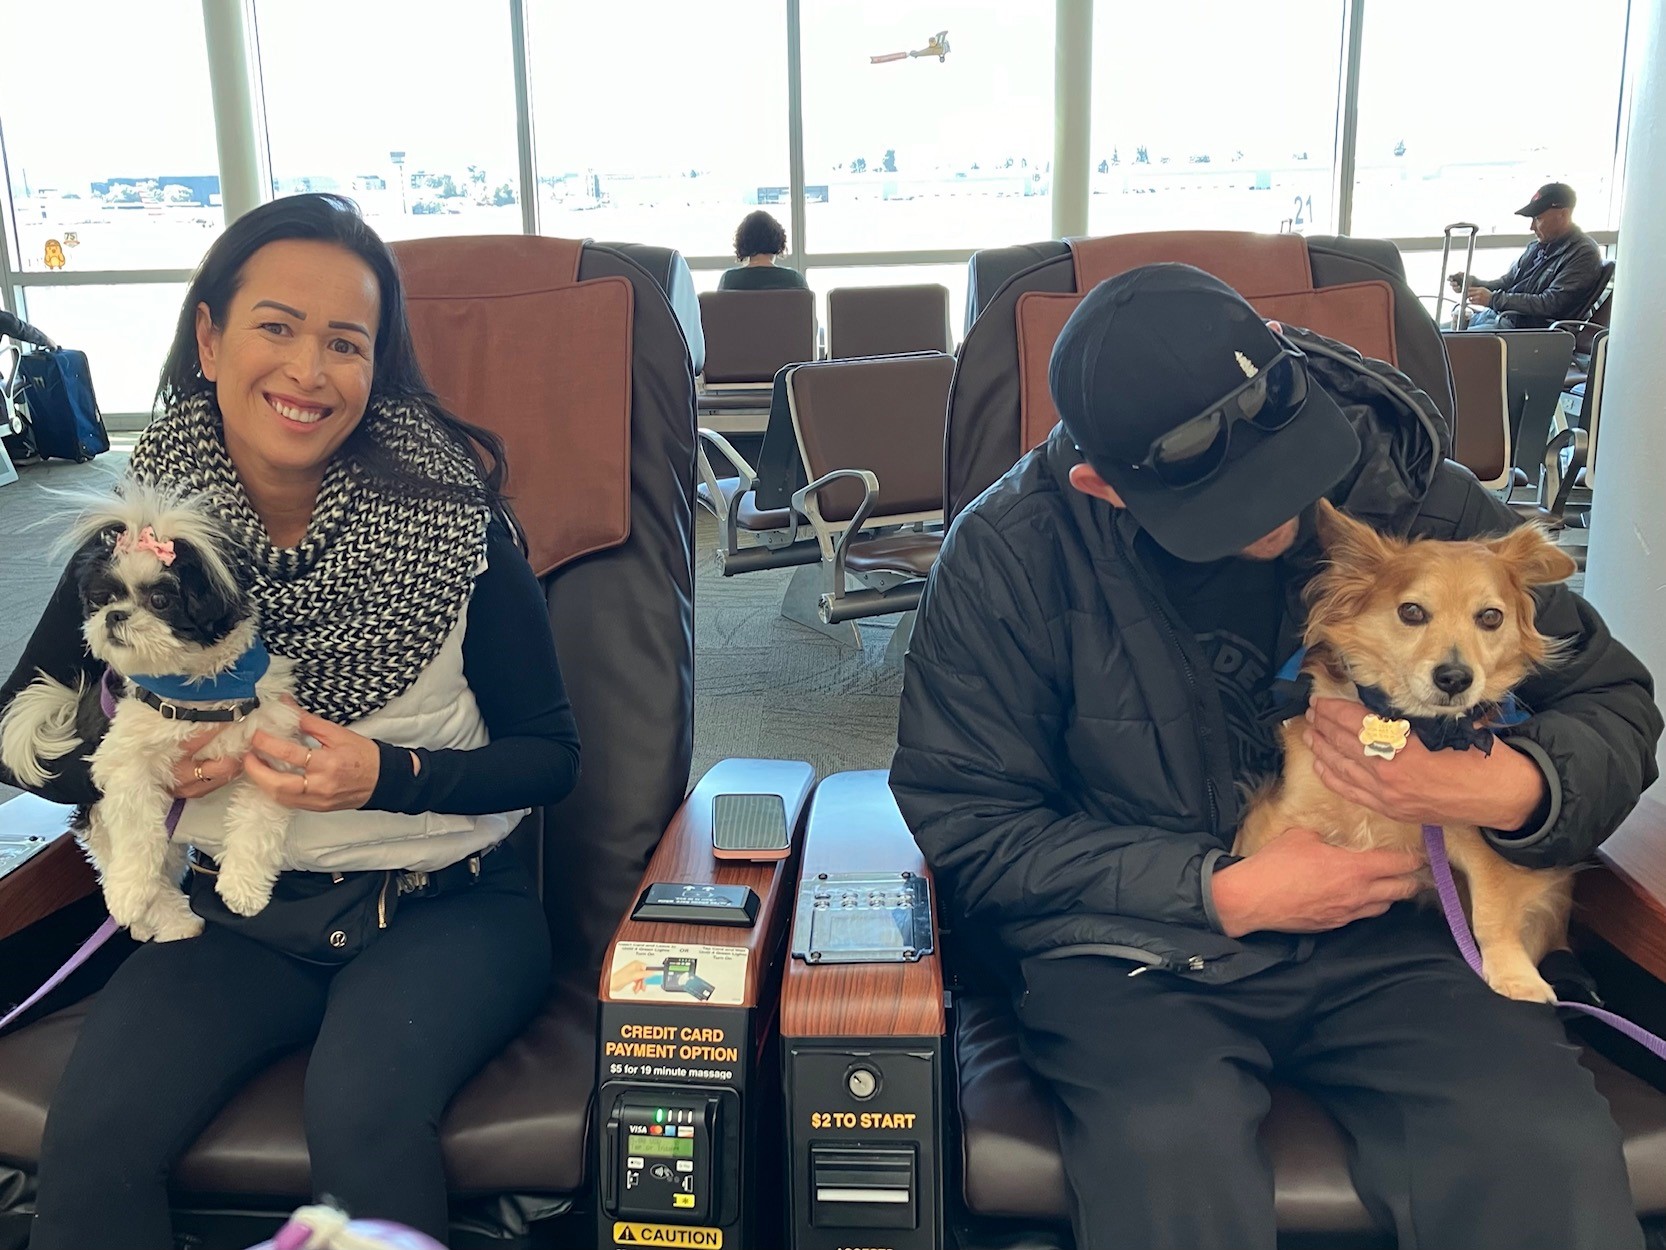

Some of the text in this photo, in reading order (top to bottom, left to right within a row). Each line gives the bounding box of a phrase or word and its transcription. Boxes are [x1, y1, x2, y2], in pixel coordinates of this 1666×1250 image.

[1294, 195, 1312, 224] 21
[64, 232, 75, 240] 75
[620, 1024, 724, 1042] CREDIT CARD
[606, 1042, 738, 1062] PAYMENT OPTION
[610, 1063, 733, 1080] $5 for 19 minute massage
[629, 1125, 647, 1133] VISA
[811, 1112, 916, 1129] $2 TO START
[641, 1228, 717, 1245] CAUTION
